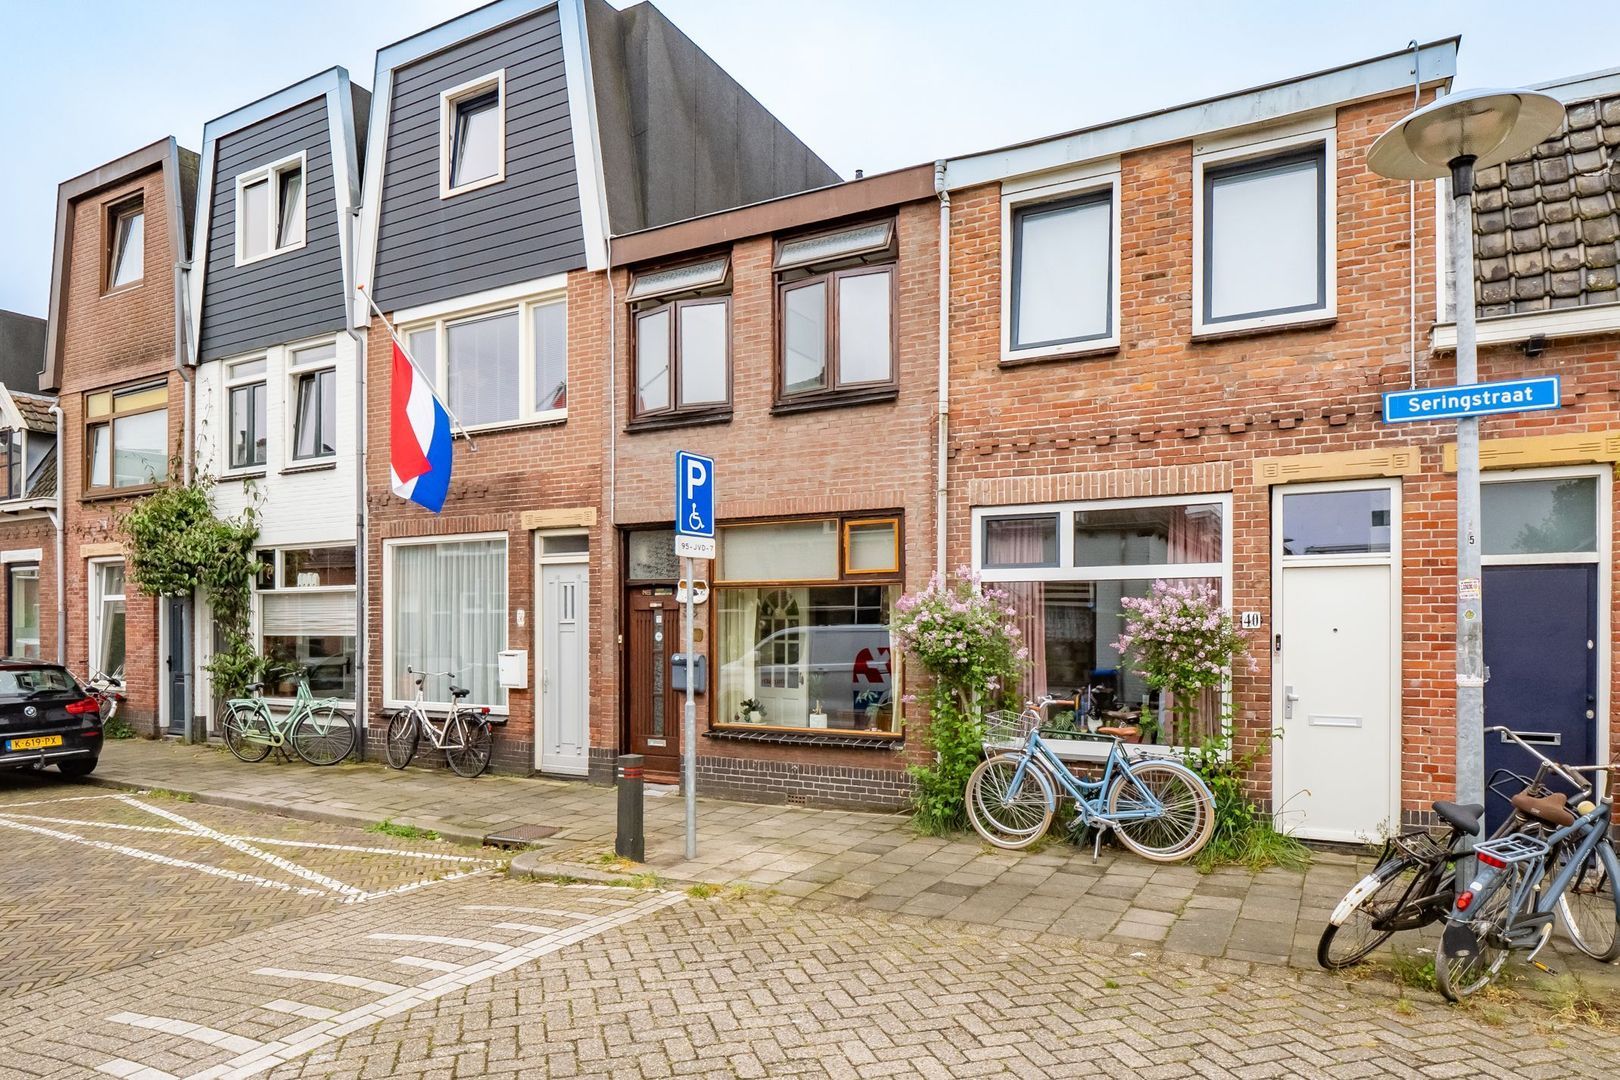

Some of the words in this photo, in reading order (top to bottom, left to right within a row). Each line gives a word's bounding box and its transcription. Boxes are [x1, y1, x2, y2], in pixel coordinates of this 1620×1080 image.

[1408, 387, 1533, 412] Seringstraat
[687, 458, 707, 499] P
[1469, 535, 1475, 545] 5
[1243, 613, 1259, 627] 40
[14, 737, 57, 748] K-619-PX
